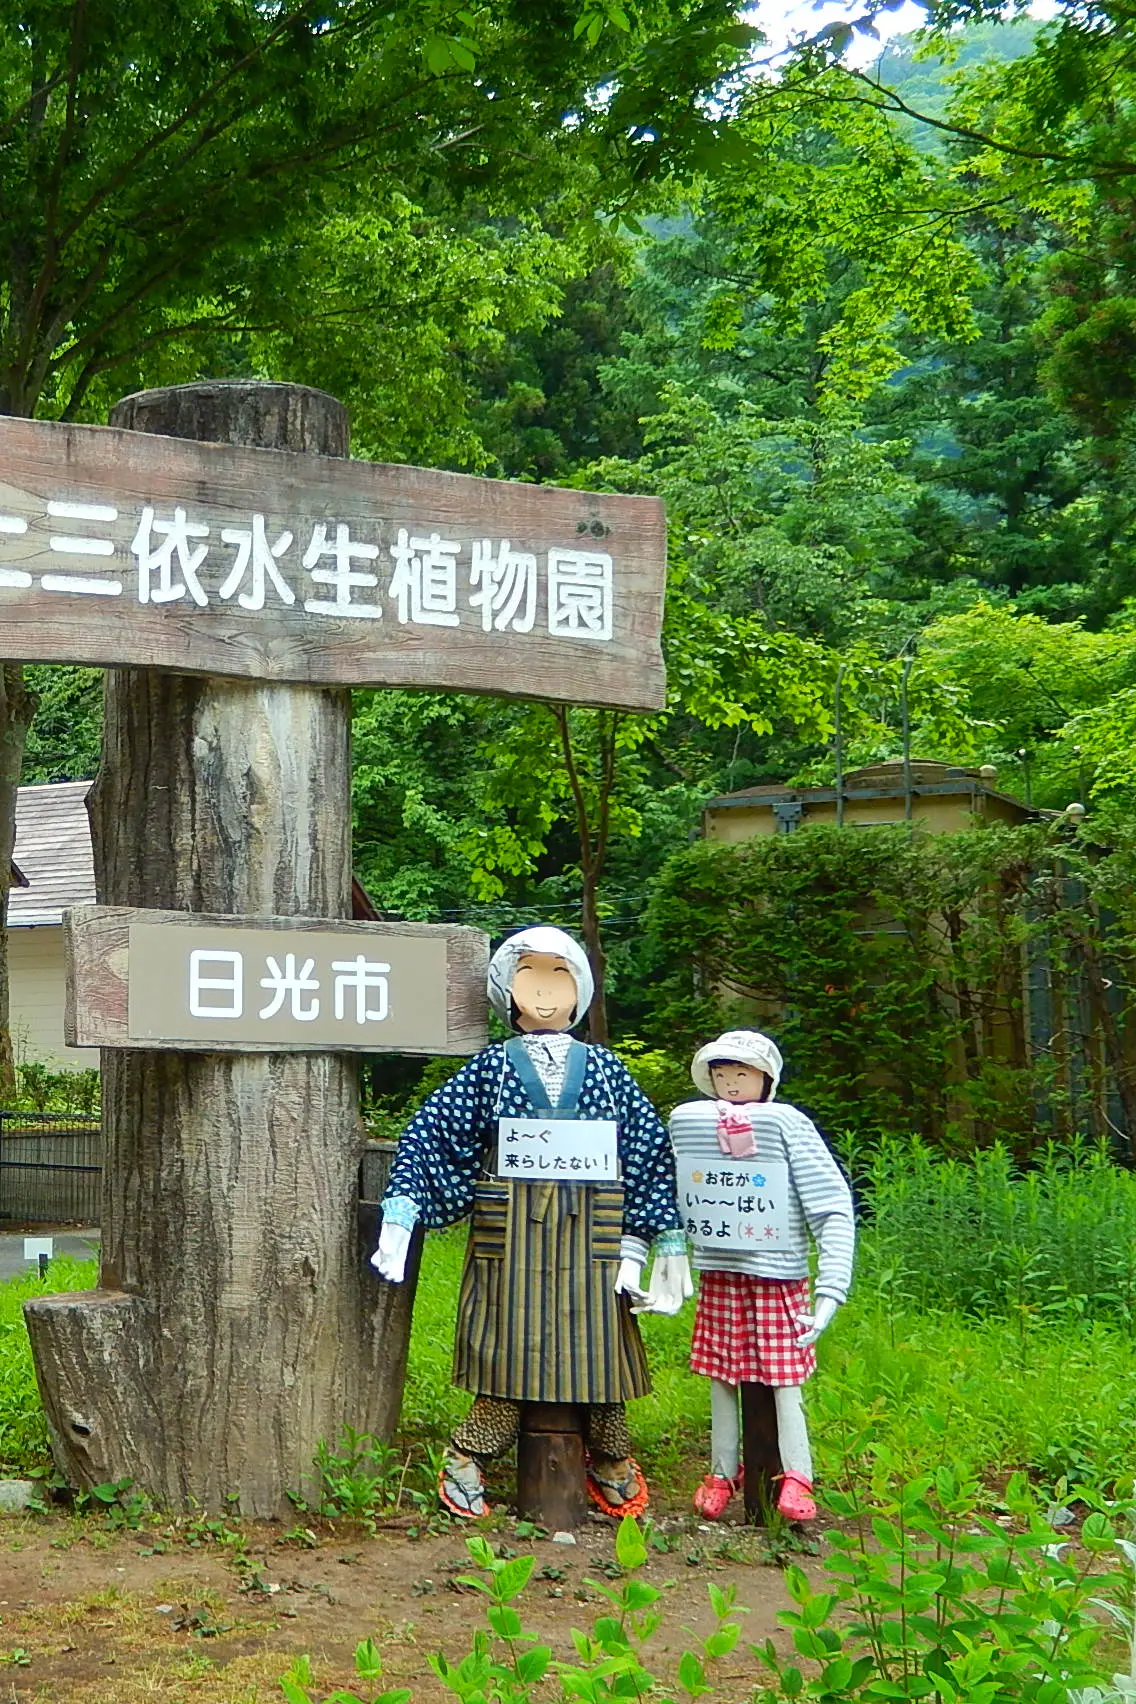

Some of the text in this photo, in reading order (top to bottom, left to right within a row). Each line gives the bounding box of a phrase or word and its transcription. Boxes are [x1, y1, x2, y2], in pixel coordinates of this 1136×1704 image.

[189, 949, 392, 1025] 日光市
[705, 1171, 750, 1188] お花が
